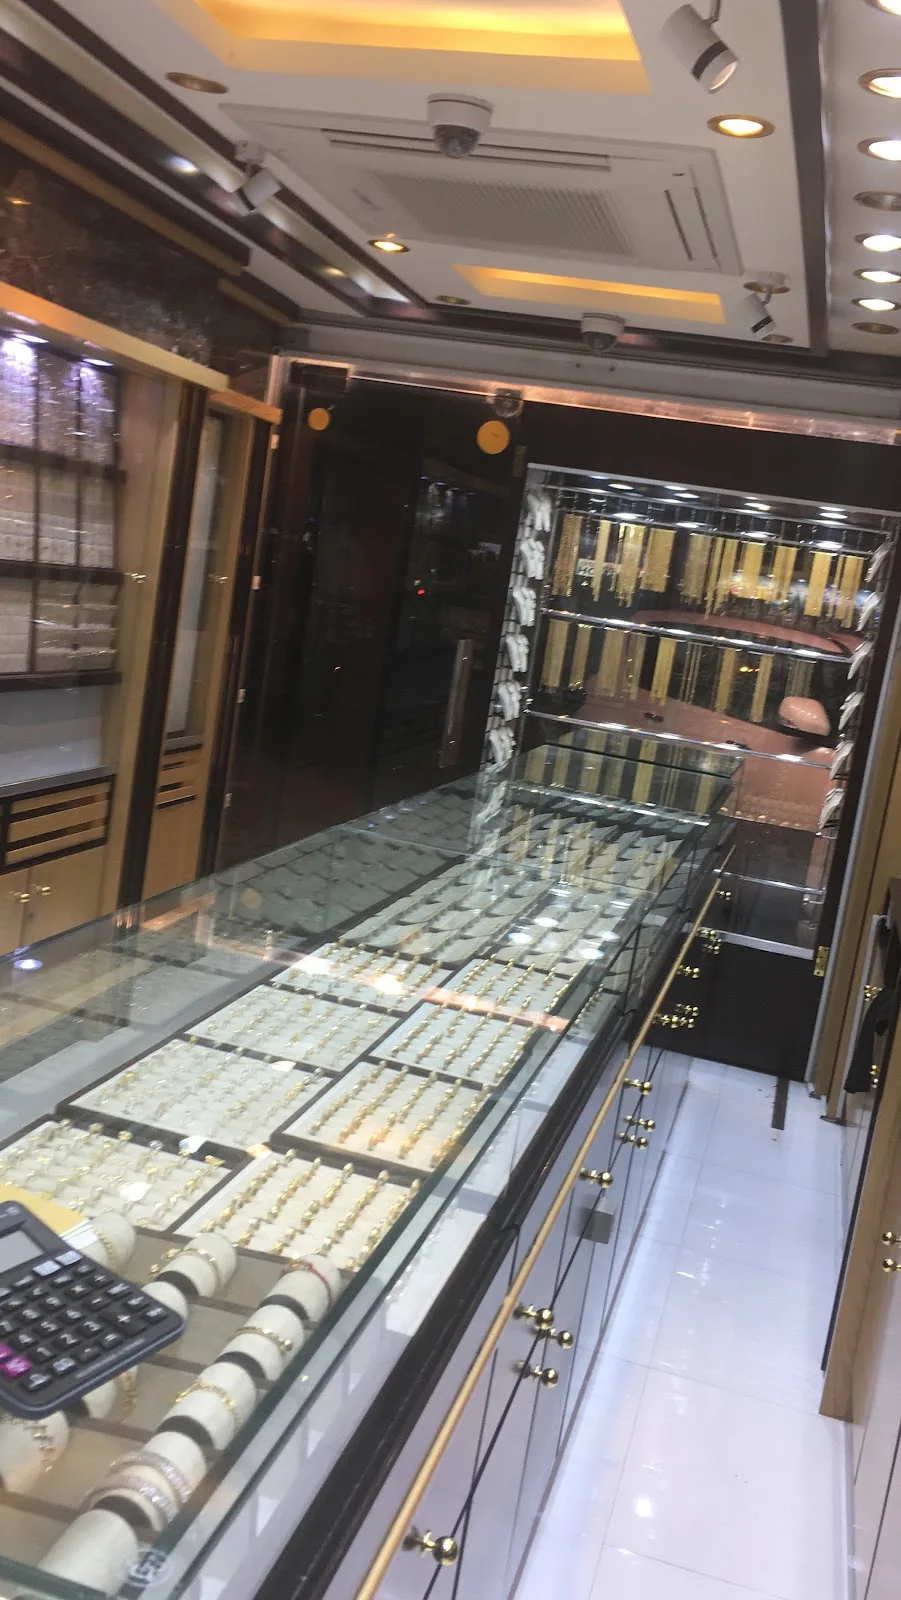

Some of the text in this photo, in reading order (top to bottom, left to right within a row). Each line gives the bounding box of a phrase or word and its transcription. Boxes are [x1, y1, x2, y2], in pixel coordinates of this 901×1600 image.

[40, 1321, 58, 1332] 5
[84, 1321, 101, 1332] 3
[60, 1334, 78, 1345] 2
